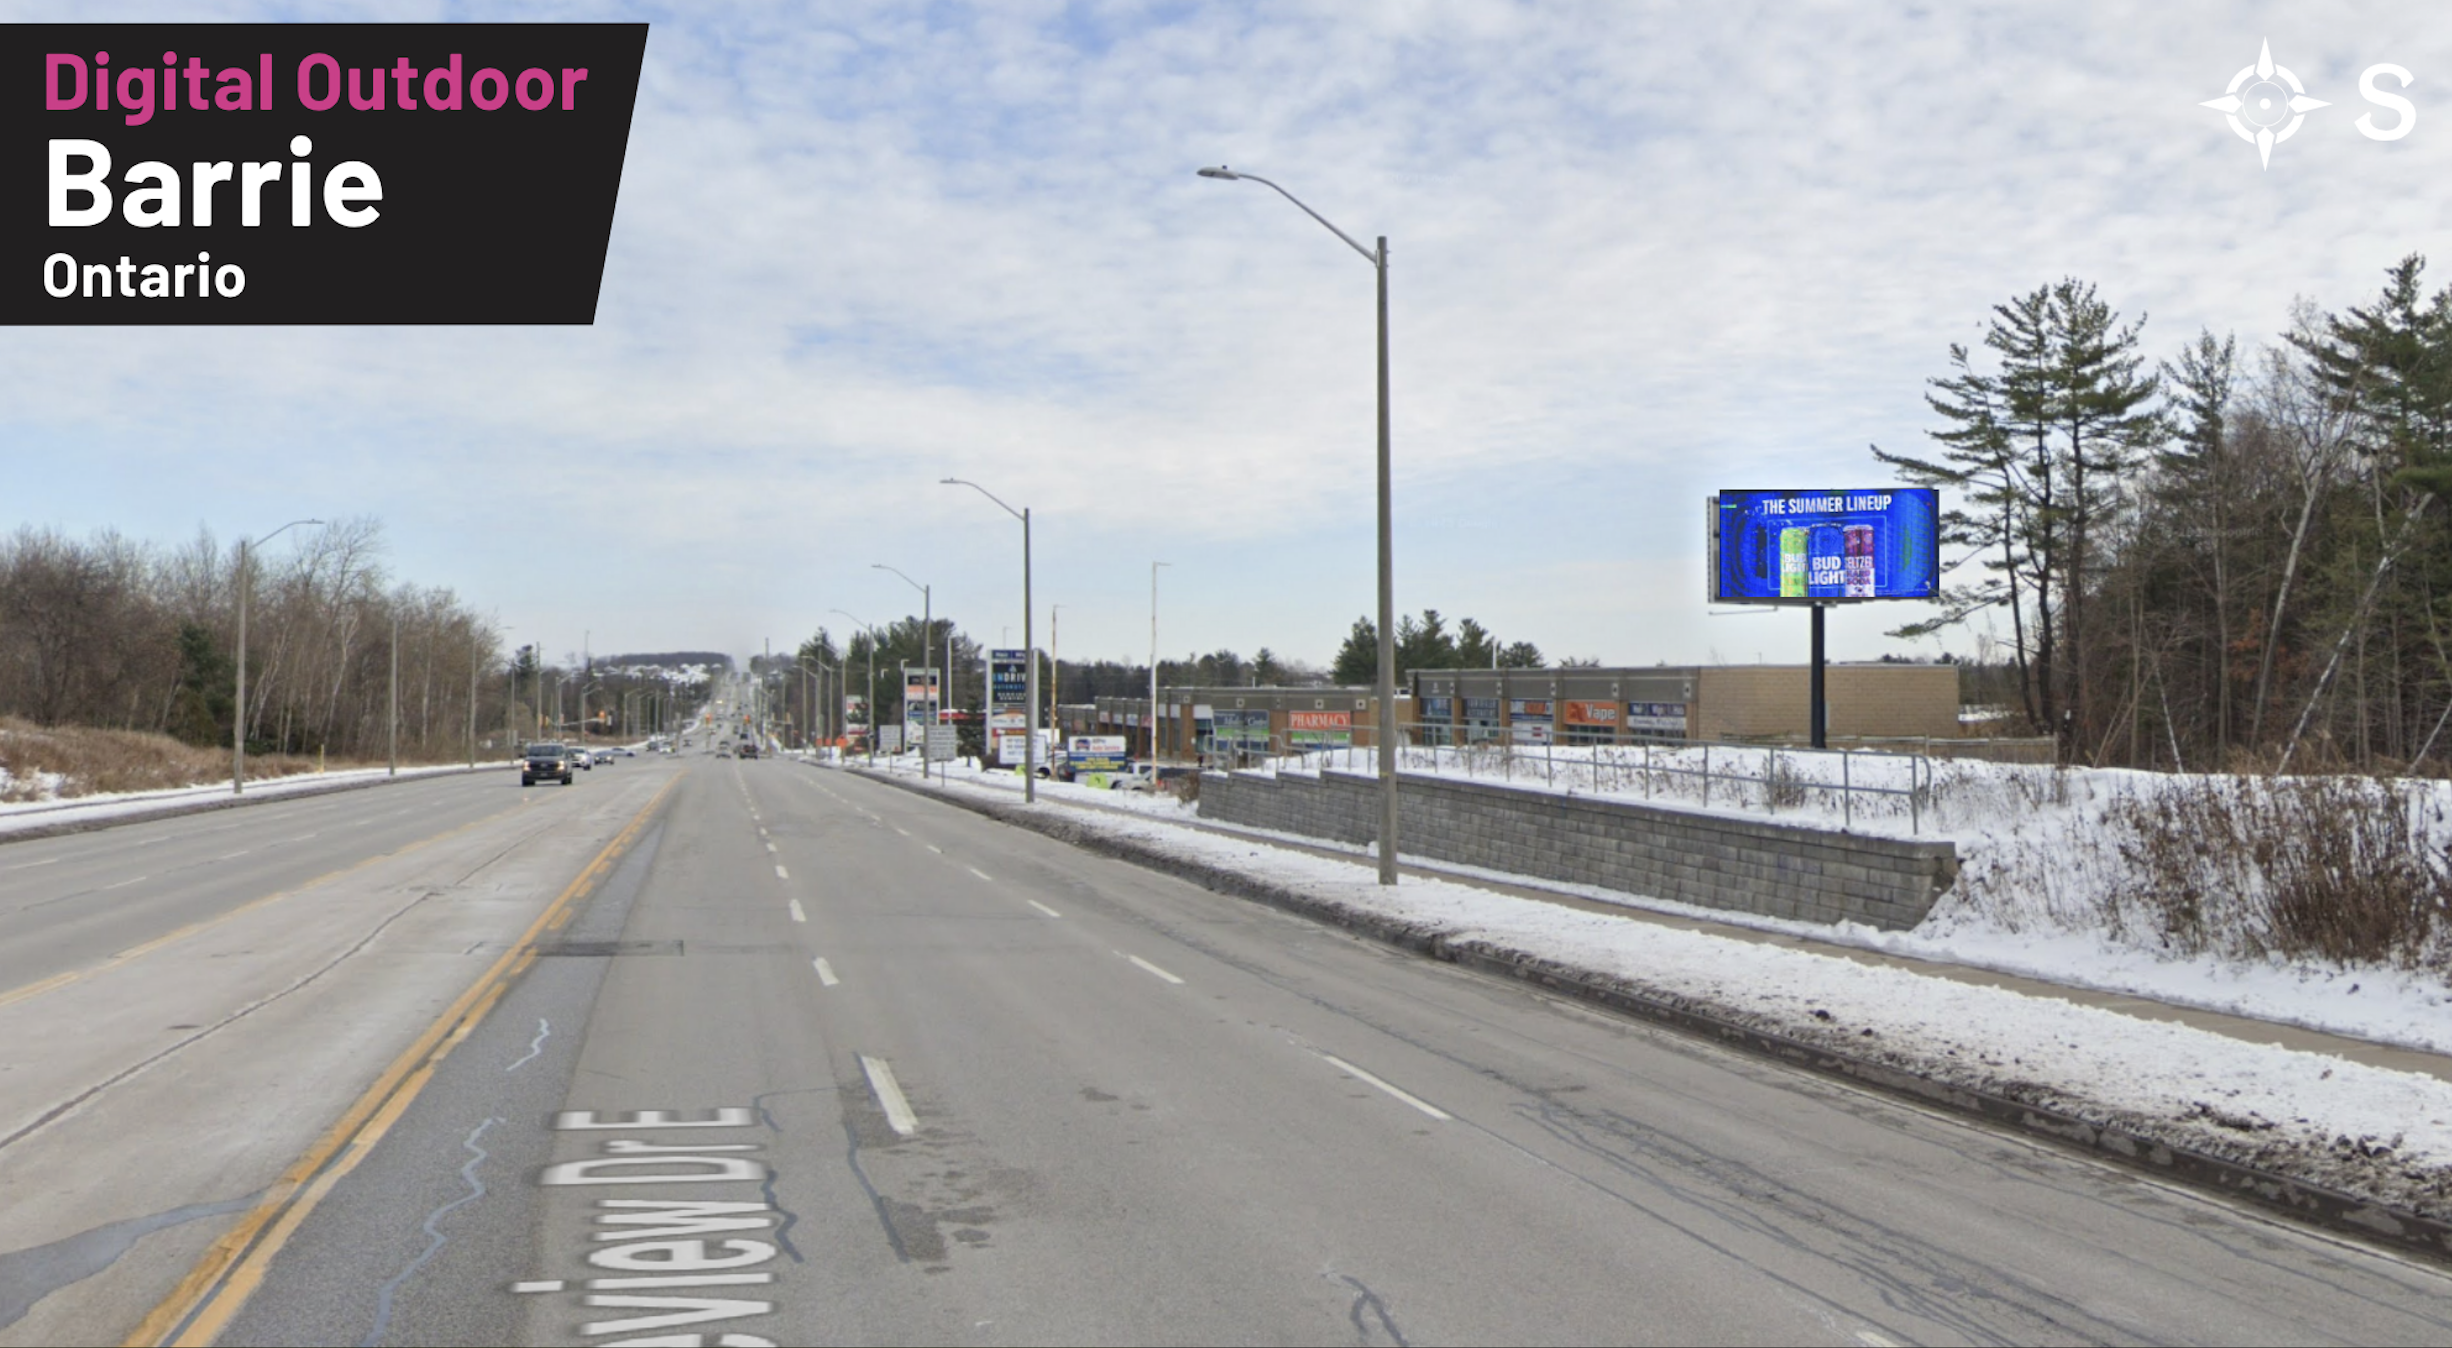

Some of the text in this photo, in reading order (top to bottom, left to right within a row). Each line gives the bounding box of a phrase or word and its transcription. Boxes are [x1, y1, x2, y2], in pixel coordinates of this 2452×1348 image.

[1762, 494, 1892, 515] THE SUMMER LINEUP
[1781, 562, 1806, 573] LIGH
[1812, 556, 1842, 571] BUD
[1808, 570, 1846, 585] LIGHT
[1585, 703, 1616, 721] Vape
[1291, 713, 1347, 729] PHARMACY
